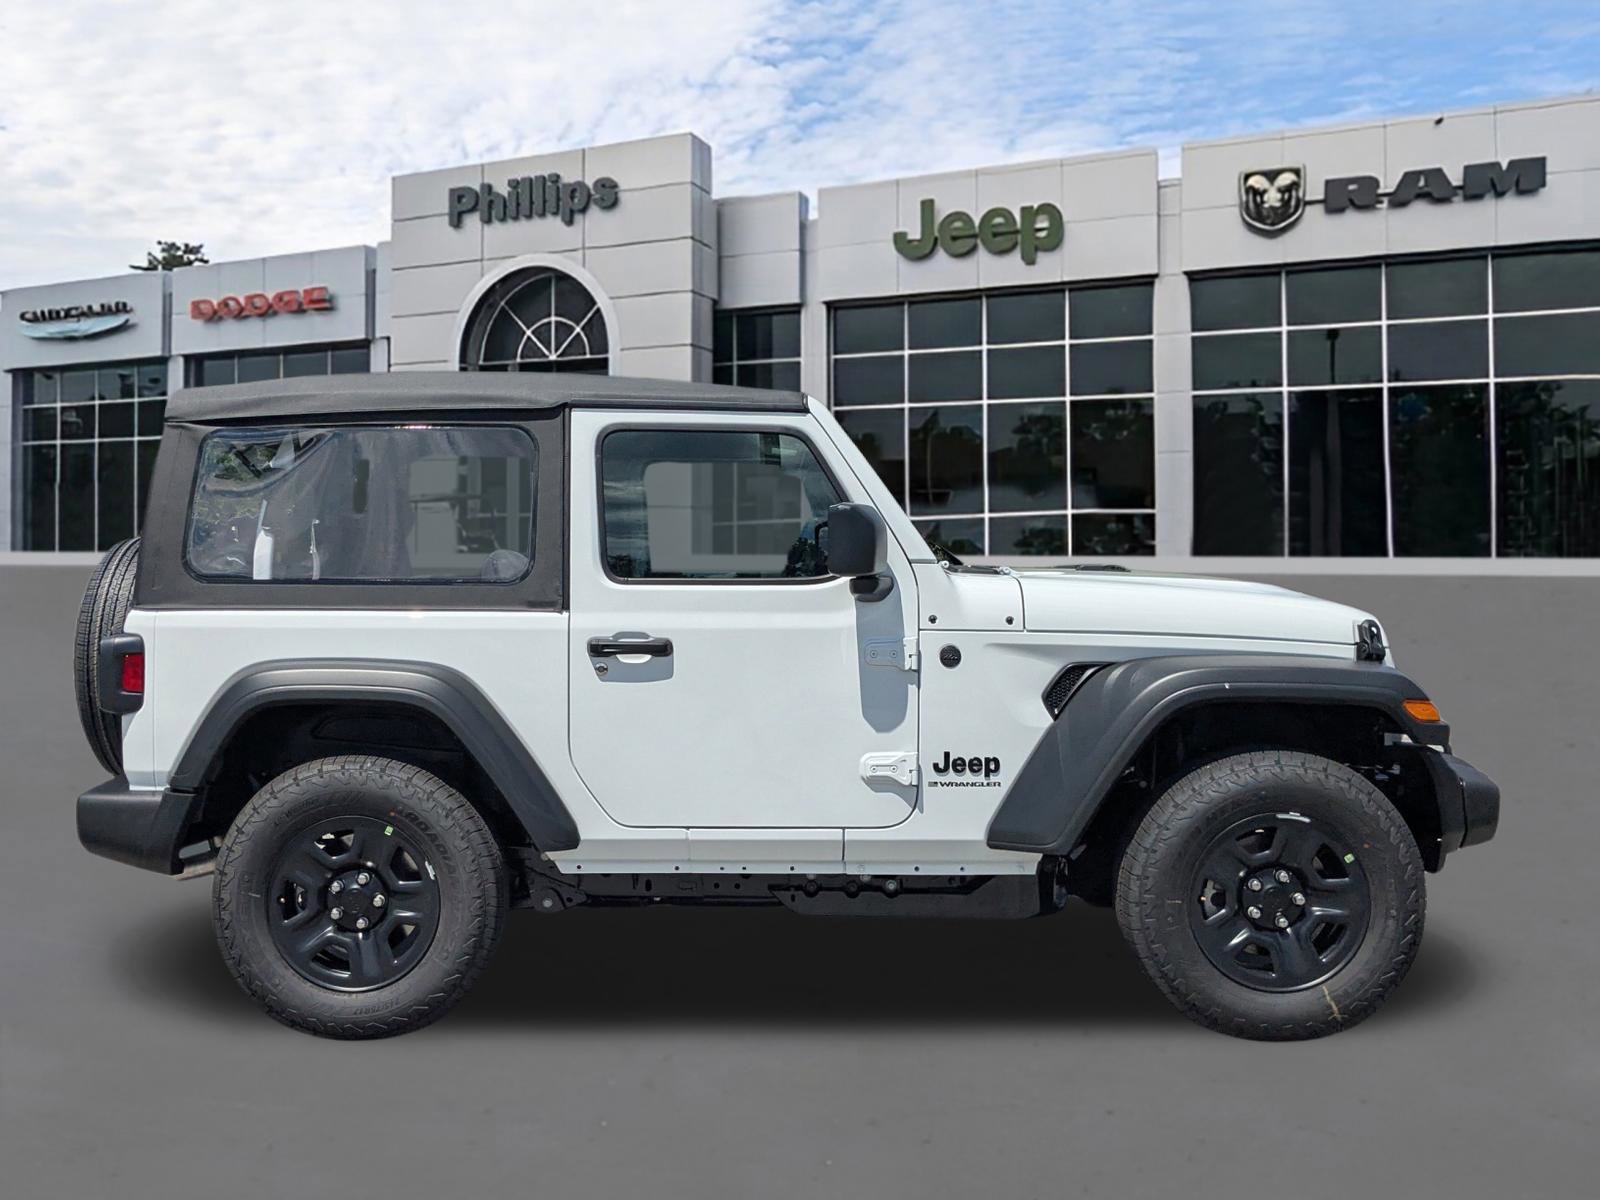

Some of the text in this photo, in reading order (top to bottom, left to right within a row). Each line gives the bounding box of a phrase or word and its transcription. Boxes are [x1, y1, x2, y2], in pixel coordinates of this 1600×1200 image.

[448, 172, 620, 228] Phillips
[1324, 156, 1547, 214] RAM
[893, 198, 1064, 266] Jeep
[190, 286, 330, 321] DODGE
[932, 751, 1001, 778] Jeep
